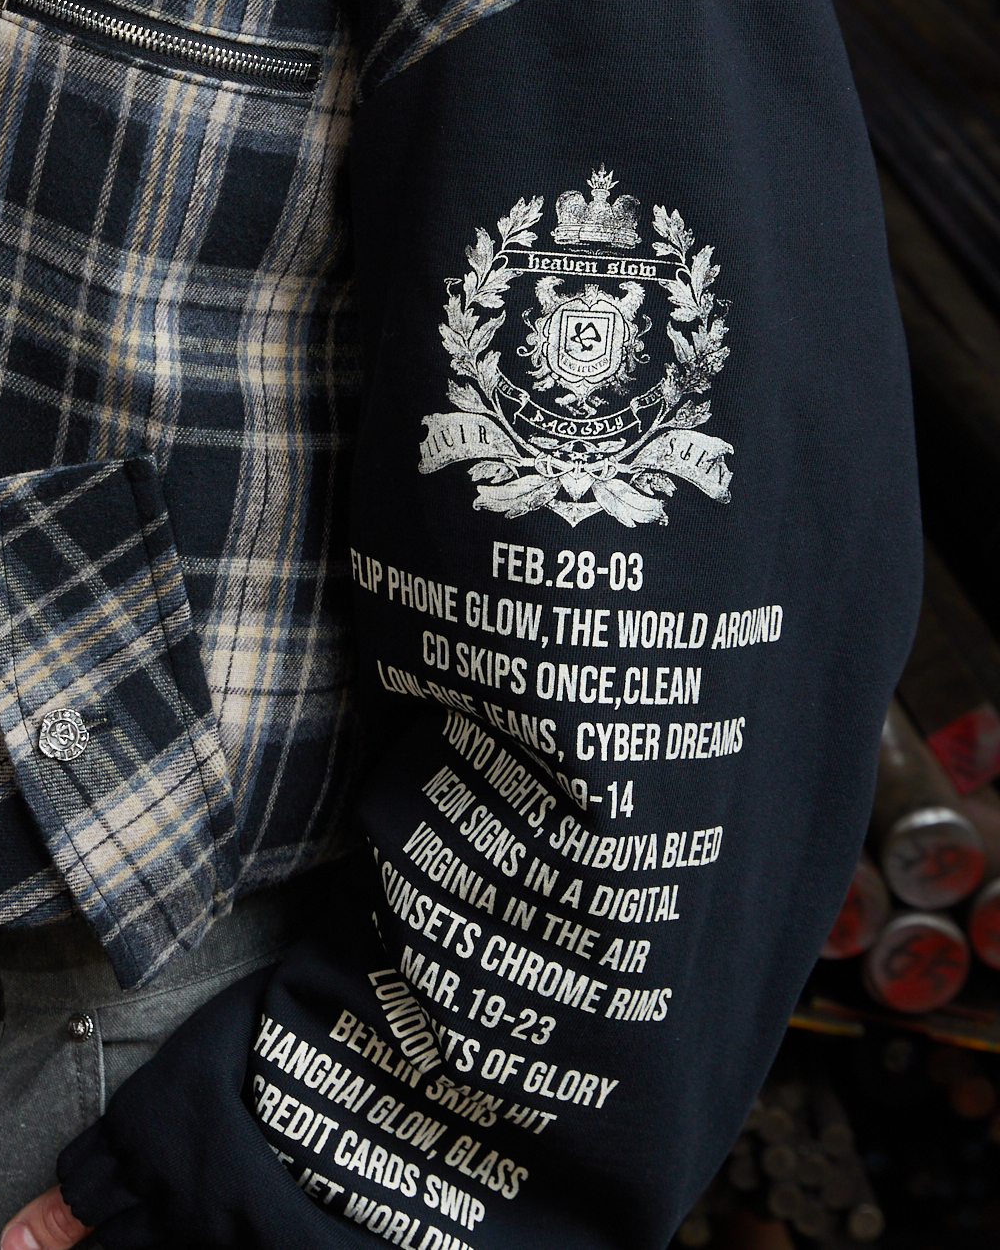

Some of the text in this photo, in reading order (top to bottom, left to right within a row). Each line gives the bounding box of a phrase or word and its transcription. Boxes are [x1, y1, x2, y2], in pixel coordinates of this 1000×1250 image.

[527, 253, 657, 277] heaven slow
[351, 548, 382, 593] FLIP
[388, 566, 457, 623] PHONE
[618, 610, 708, 649] WORLD
[711, 605, 783, 649] AROUND
[423, 631, 449, 670] CD
[456, 642, 527, 694] SKIPS
[443, 708, 495, 770] TOKYO
[484, 749, 556, 838] NIGHTS,
[549, 816, 657, 871] SHIBUYA
[662, 826, 723, 868] BLEED
[576, 722, 660, 761] CYBER
[666, 717, 745, 760] DREAMS
[403, 821, 650, 973] VIRGINIA IN THE AIR
[422, 766, 679, 923] NEON SIGNS IN A DIGITAL
[382, 861, 672, 1021] SUNSETS CHROME RIMS
[401, 945, 556, 1045] MAR. 19-23
[254, 1014, 528, 1199] HANGHAI GLOW, GLASS
[368, 969, 442, 1075] LONDON
[481, 1049, 525, 1084] OF
[523, 1061, 619, 1108] GLORY
[254, 1075, 485, 1231] CREDIT CARDS SWIP
